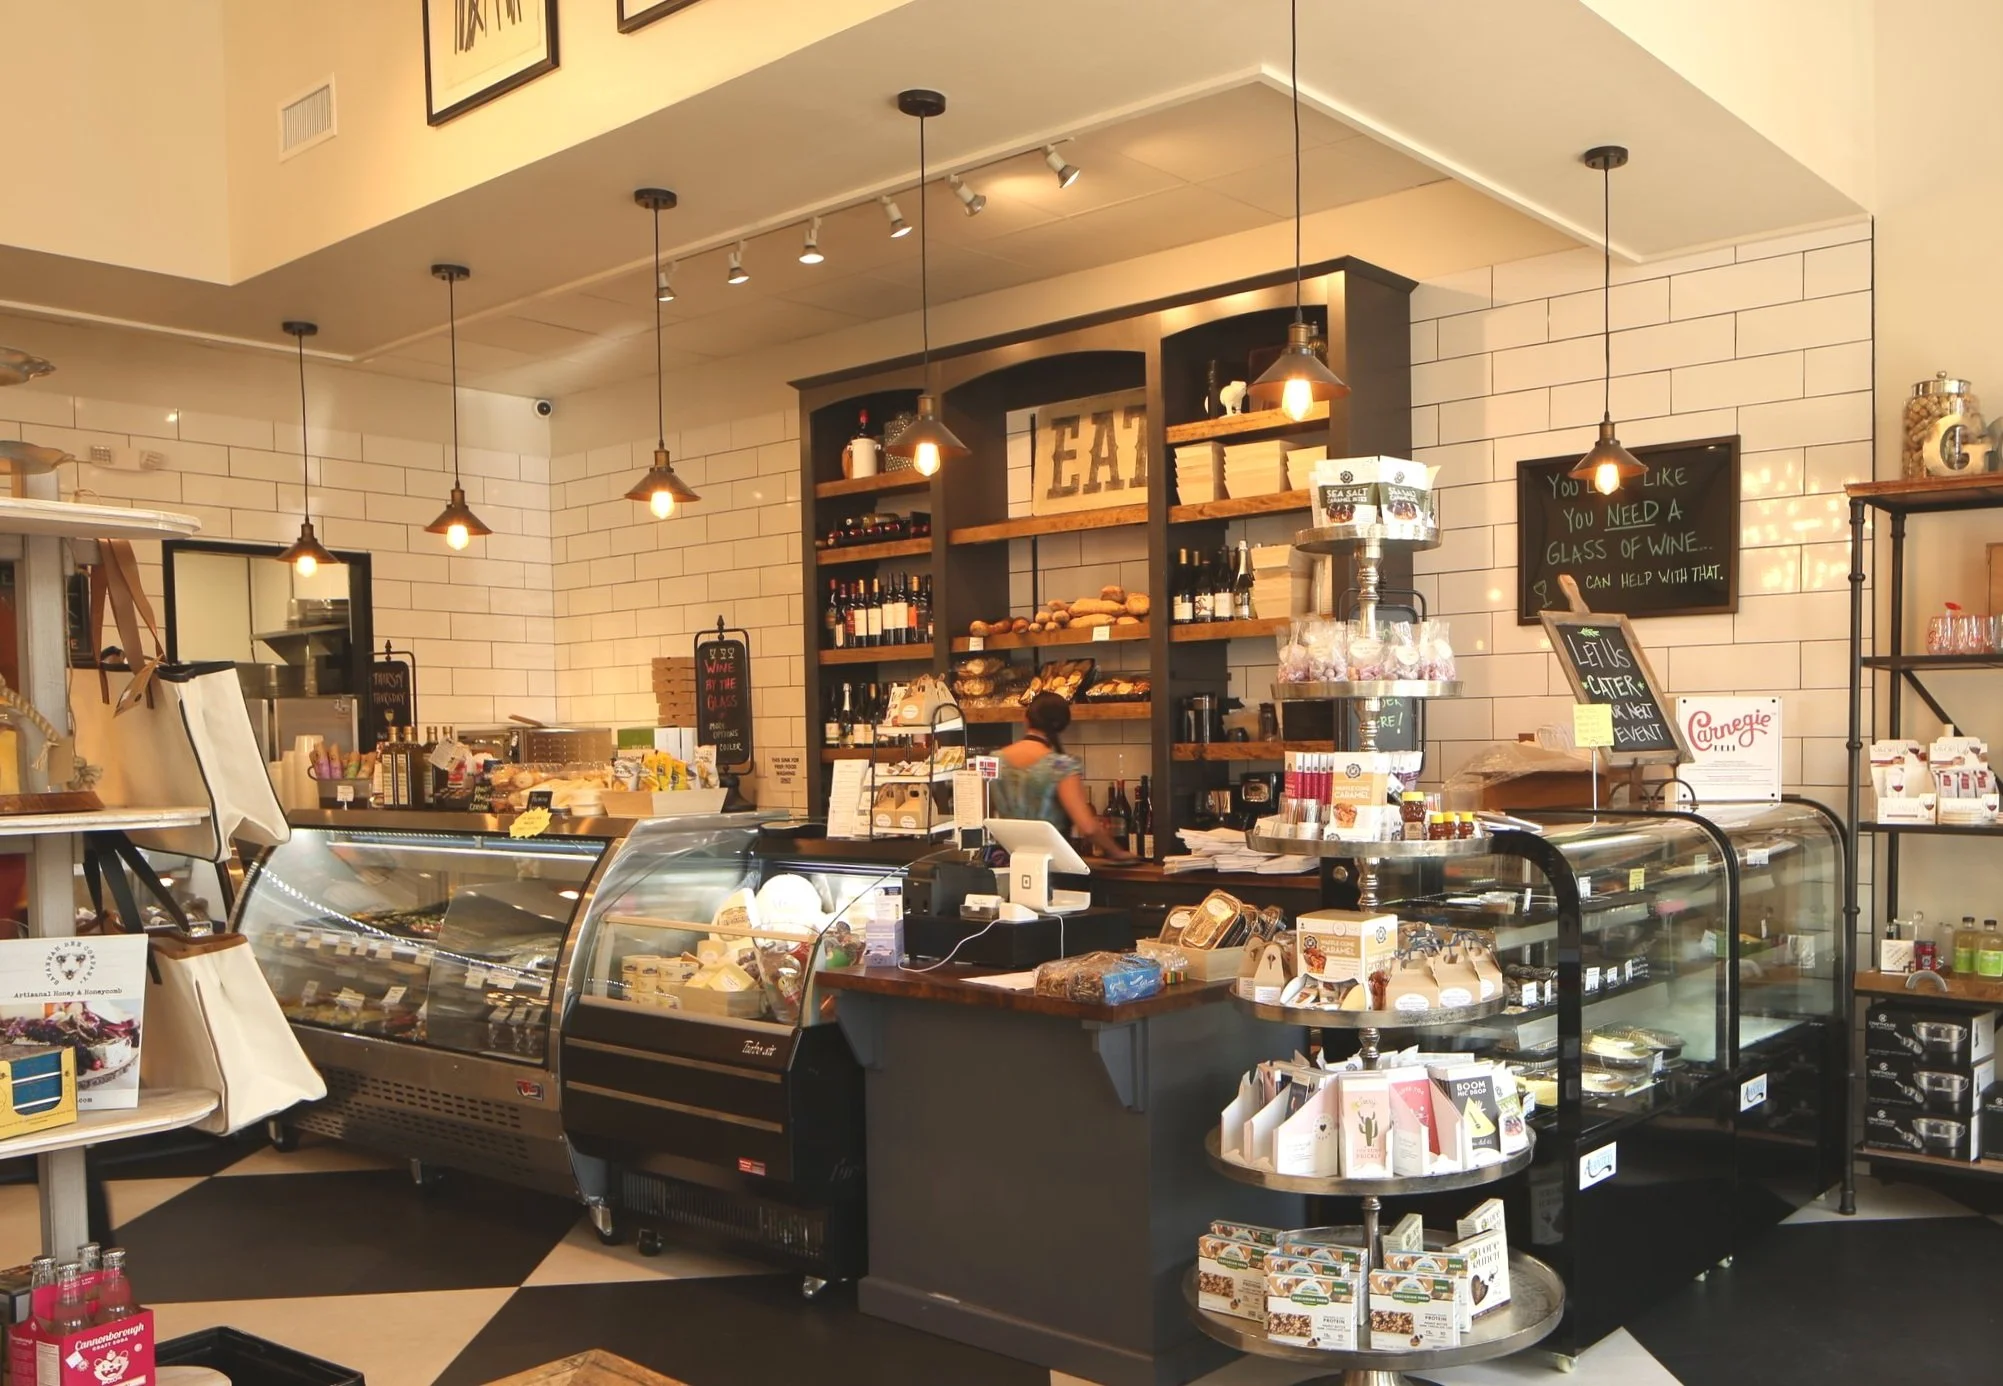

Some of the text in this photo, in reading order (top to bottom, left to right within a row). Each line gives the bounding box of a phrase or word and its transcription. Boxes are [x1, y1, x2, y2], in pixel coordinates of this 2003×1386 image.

[1047, 404, 1148, 500] EAT
[1326, 488, 1368, 498] SEA SALT
[1547, 473, 1578, 499] YOU
[1644, 467, 1688, 487] LIKE
[1563, 498, 1683, 533] YOU NEED A
[1547, 539, 1607, 565] GLASS
[1621, 536, 1642, 560] OF
[1586, 564, 1724, 589] CAN HELP WITH THAT.
[1567, 635, 1604, 668] LET
[704, 659, 734, 674] WINE
[705, 677, 736, 691] BY THE
[1587, 675, 1642, 699] CATER
[708, 694, 738, 711] GLASS
[1625, 702, 1653, 719] NEXT
[1614, 724, 1663, 743] EVENT
[1688, 709, 1771, 751] Carnegie
[1457, 1081, 1486, 1091] BOOM
[75, 1322, 144, 1351] Cannonborough
